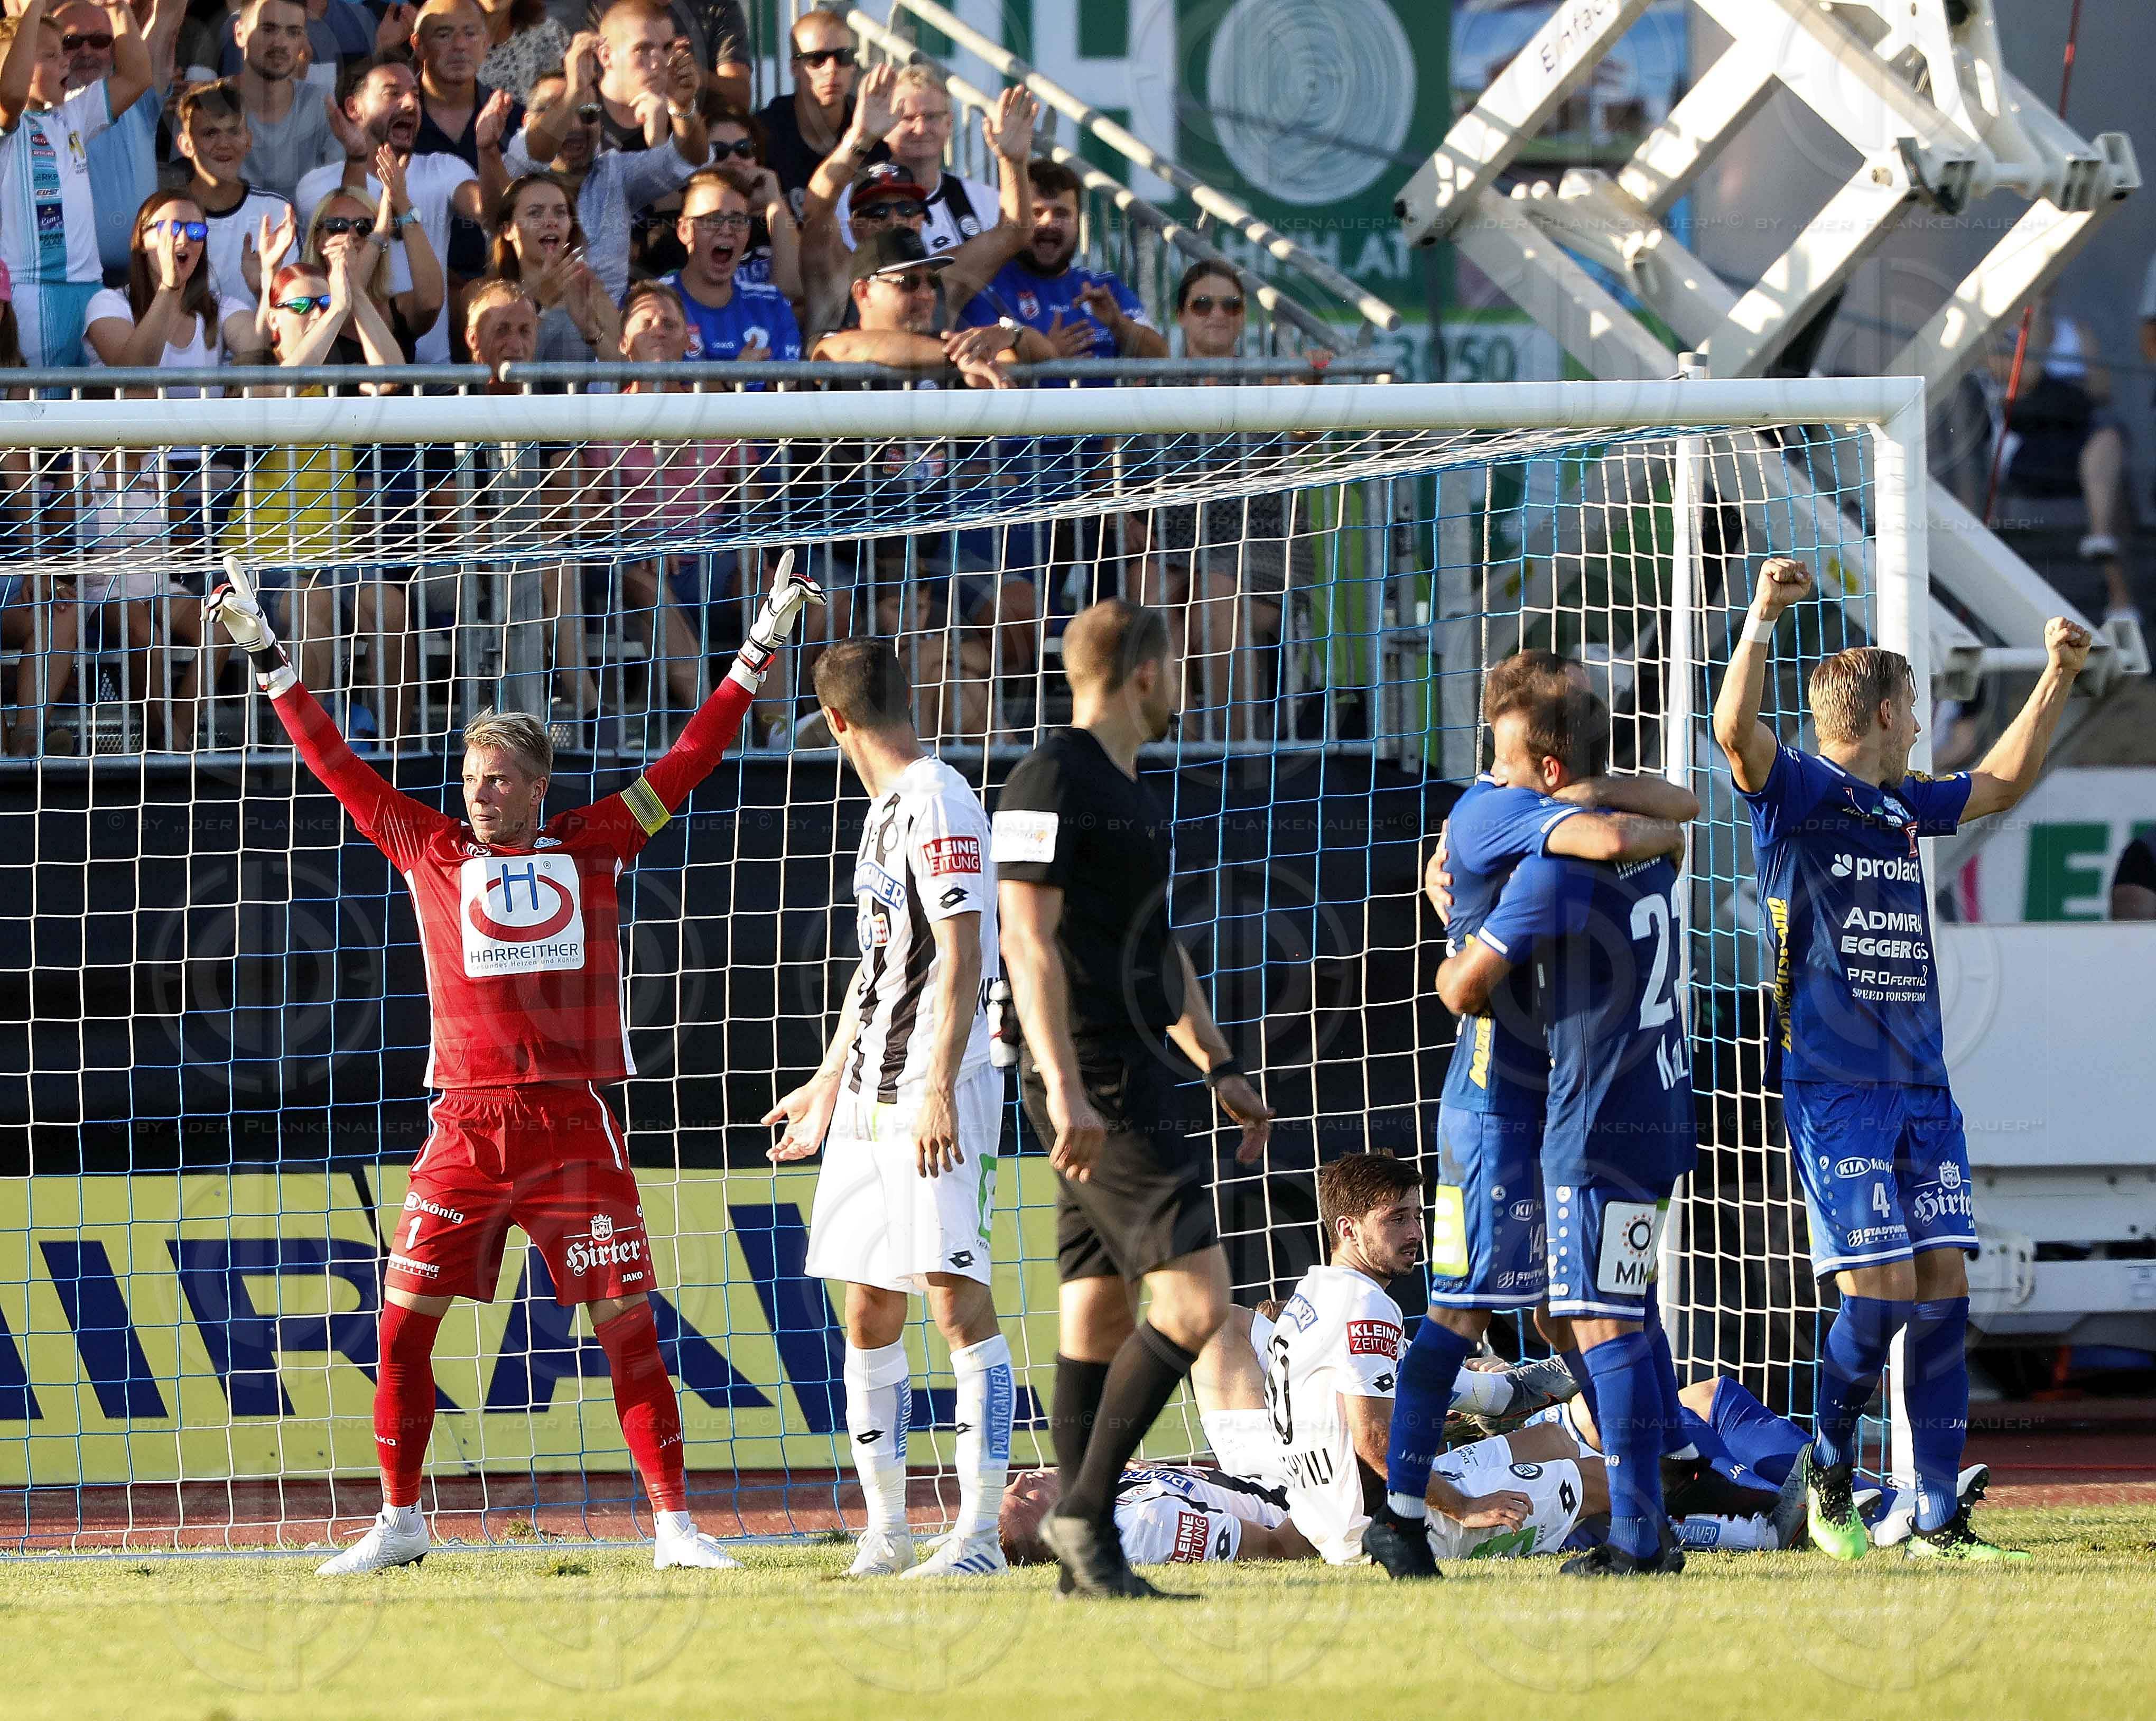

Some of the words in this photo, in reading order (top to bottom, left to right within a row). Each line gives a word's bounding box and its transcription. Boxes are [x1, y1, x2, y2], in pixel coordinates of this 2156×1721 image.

[929, 855, 979, 873] EITUNG
[470, 943, 579, 964] HARREITHER
[1841, 935, 1911, 959] EGGER
[510, 959, 537, 967] Heizen
[1839, 1162, 1866, 1176] KIA
[1872, 1182, 1891, 1218] 4
[420, 1199, 464, 1224] könig
[405, 1216, 423, 1250] 1
[566, 1238, 641, 1277] Hirter
[621, 1271, 643, 1283] JAKO
[0, 1204, 1049, 1433] IRAL
[1352, 1337, 1398, 1357] ZEITUNG
[991, 1367, 1010, 1455] PUNTIGAMER
[373, 1433, 397, 1447] AKO
[659, 1432, 681, 1449] JAK
[1174, 1514, 1194, 1562] LEINE
